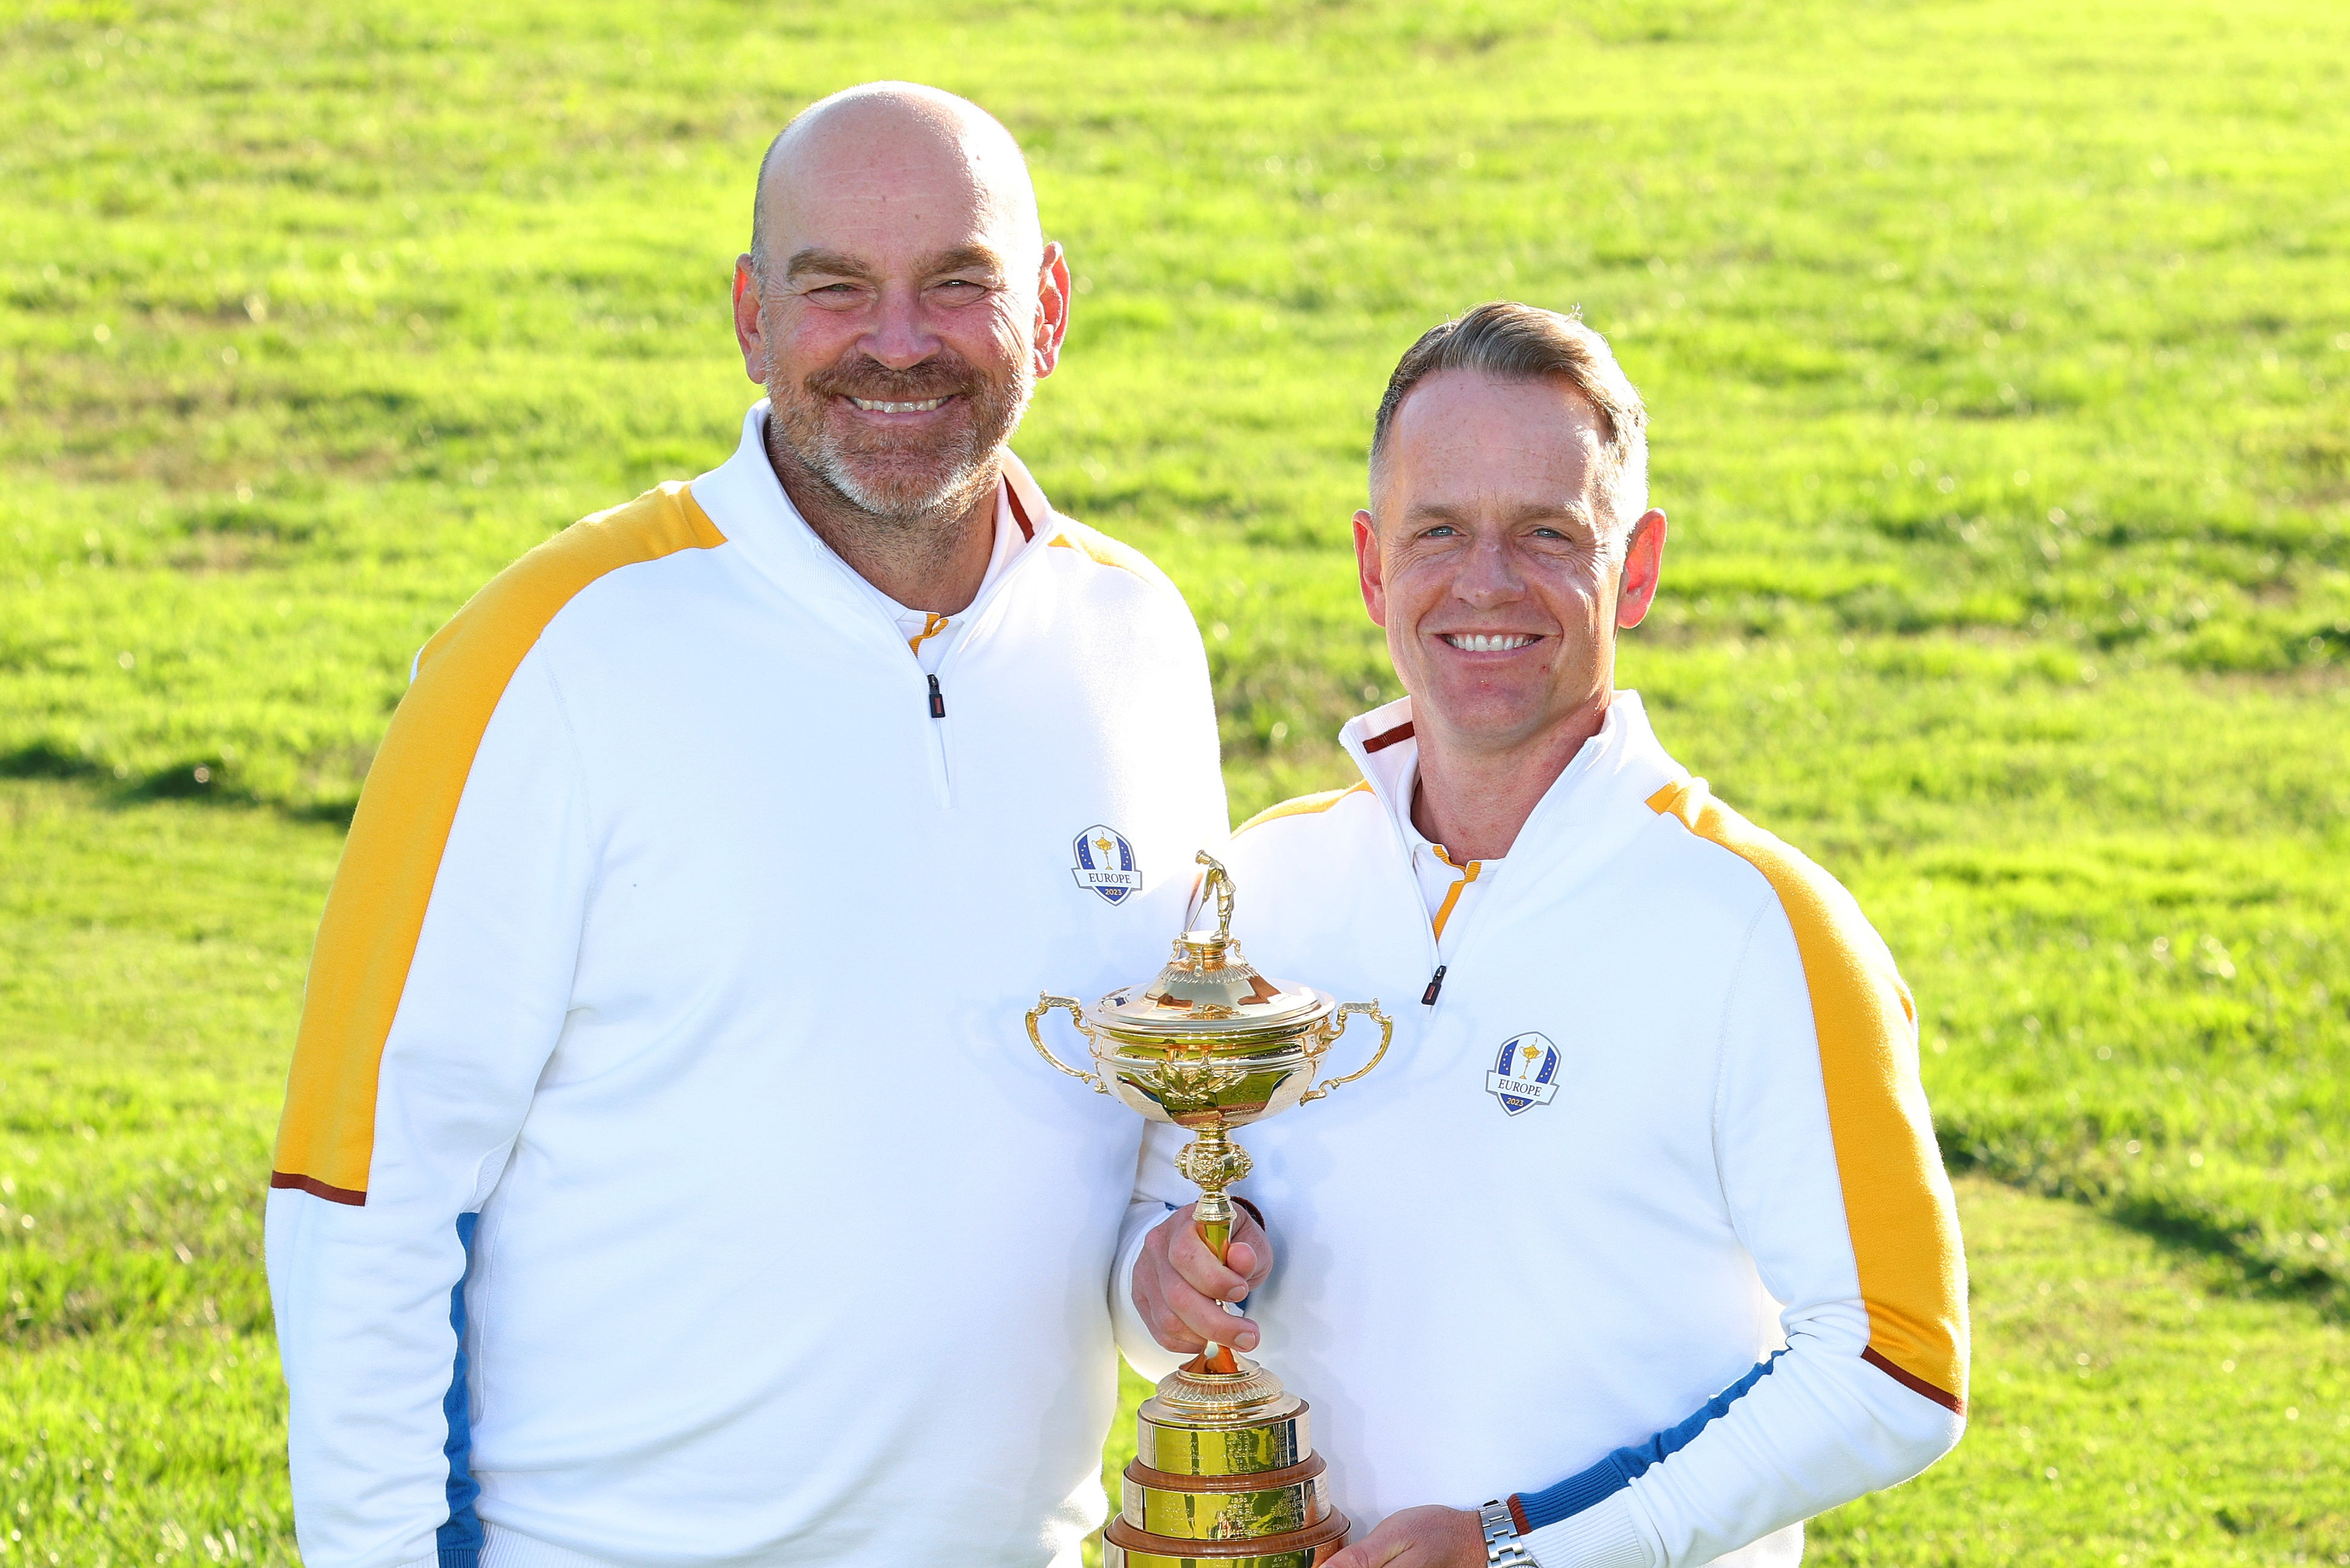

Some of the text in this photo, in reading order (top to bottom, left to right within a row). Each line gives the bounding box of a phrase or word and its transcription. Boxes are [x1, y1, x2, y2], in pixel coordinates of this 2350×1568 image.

[1088, 873, 1131, 884] EUROPE
[1497, 1078, 1542, 1097] EUROPE
[1506, 1097, 1524, 1107] 2023
